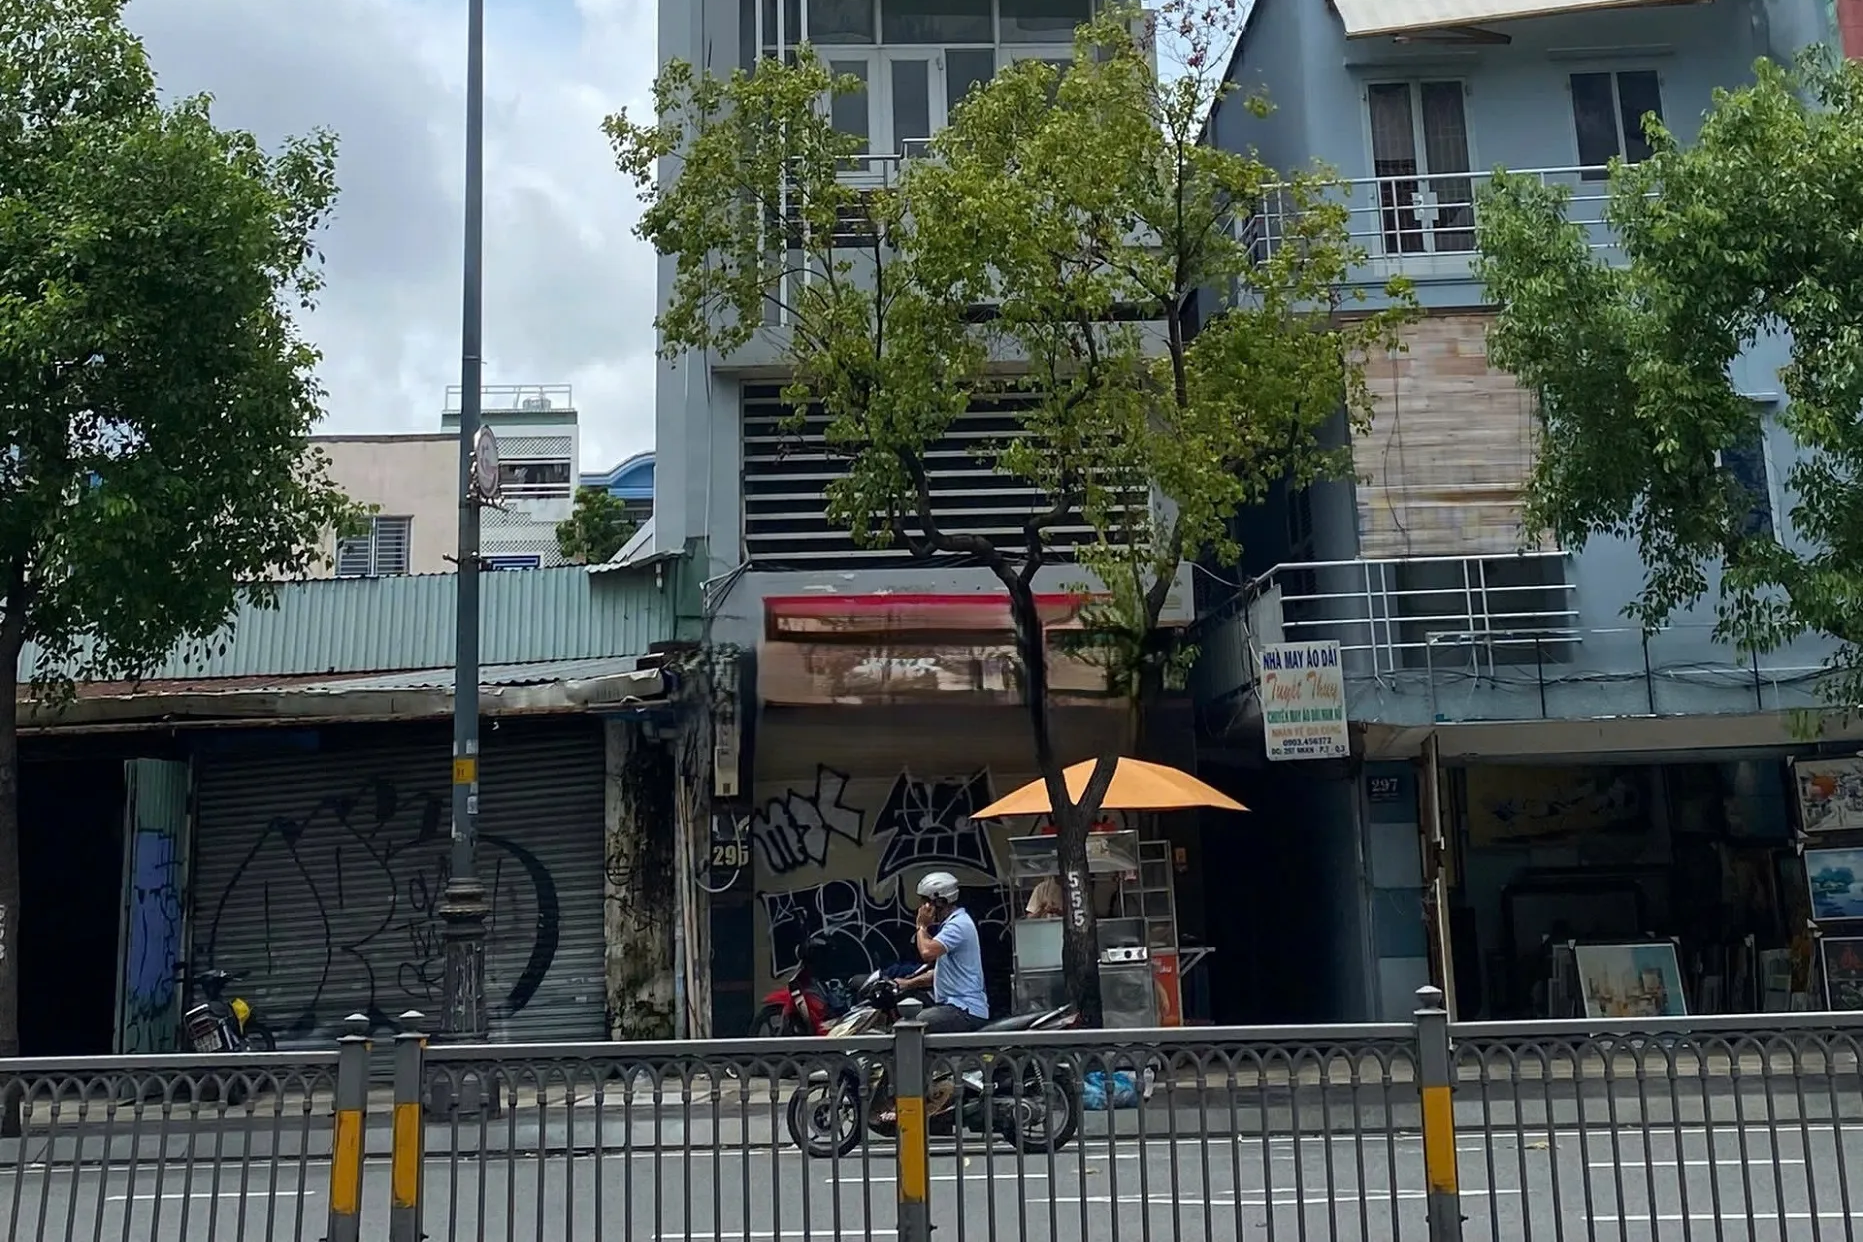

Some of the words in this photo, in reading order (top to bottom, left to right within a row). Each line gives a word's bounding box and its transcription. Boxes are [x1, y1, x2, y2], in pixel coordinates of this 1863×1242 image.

[1263, 648, 1282, 670] NHÀ
[1284, 650, 1304, 669] MAY
[1307, 645, 1320, 668] ÁO
[1321, 644, 1338, 667] DÀI
[1371, 778, 1398, 792] 297
